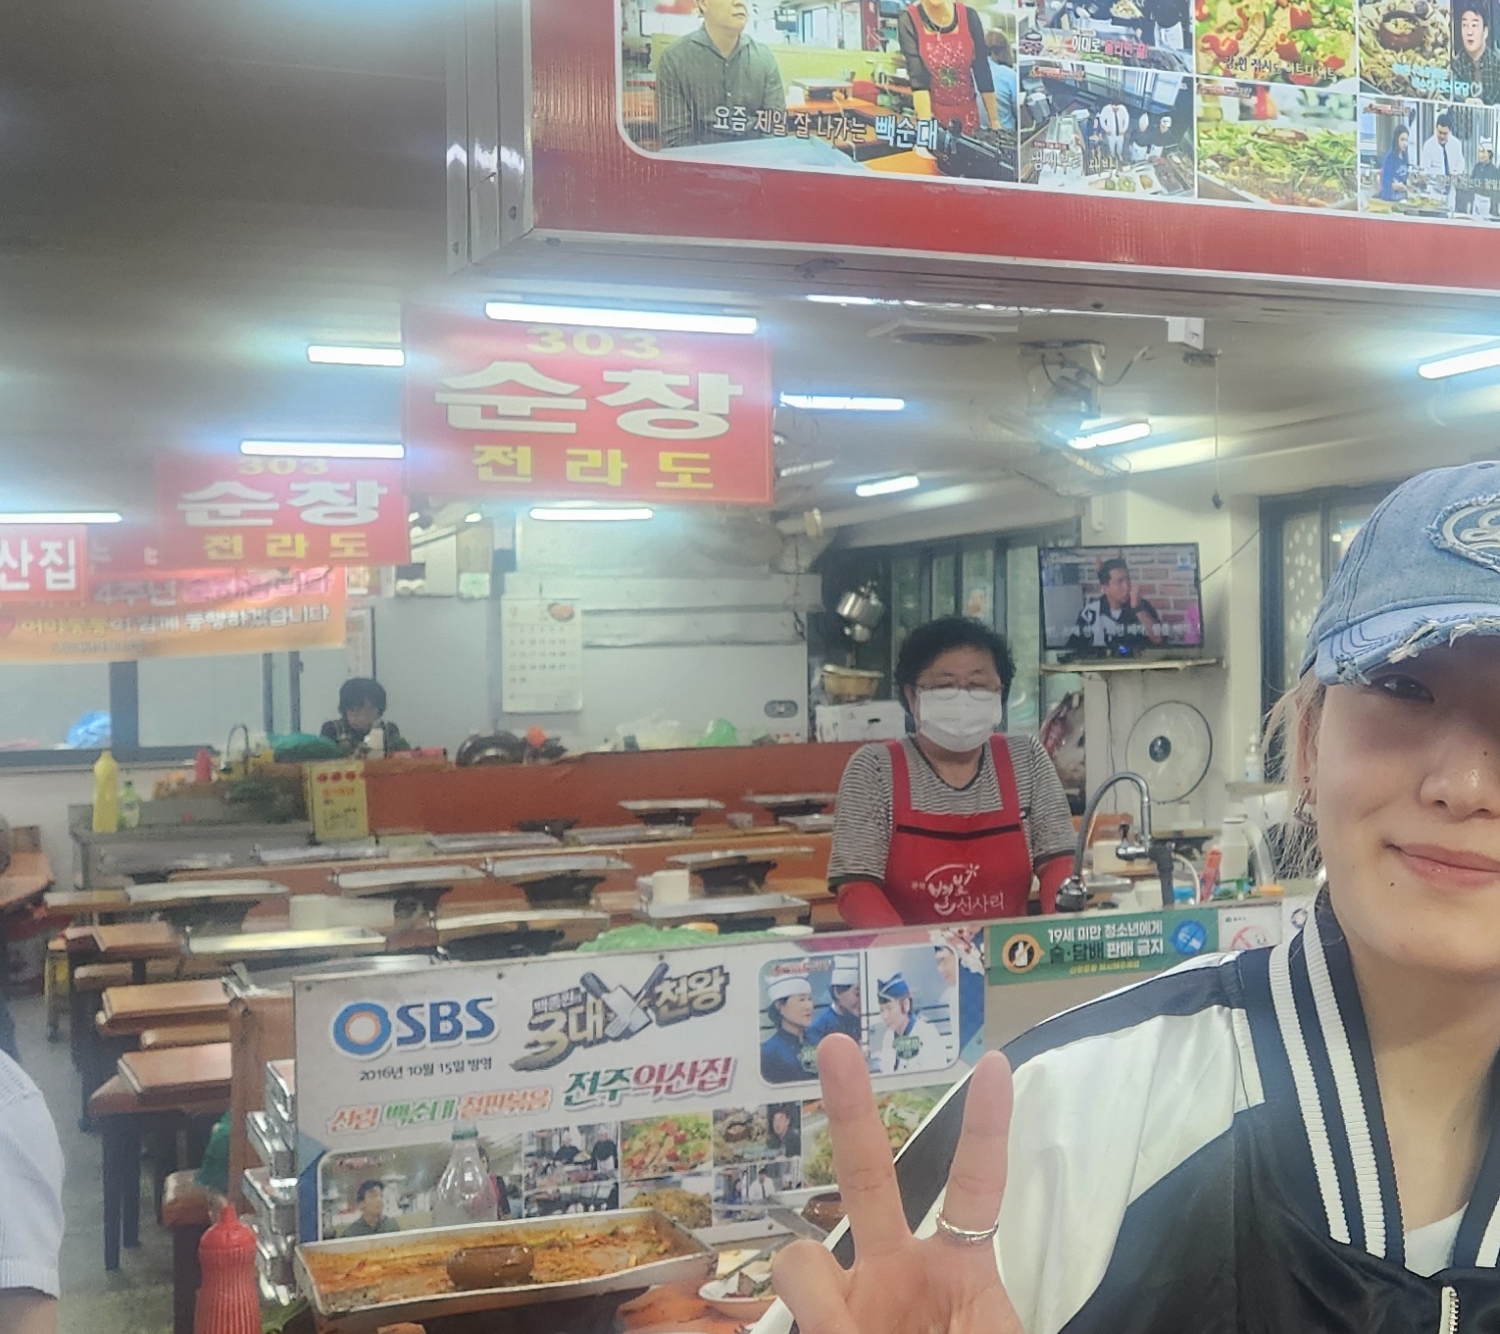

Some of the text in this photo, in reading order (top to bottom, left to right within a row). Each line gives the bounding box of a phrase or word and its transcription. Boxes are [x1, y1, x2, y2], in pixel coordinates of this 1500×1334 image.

[712, 105, 938, 151] 요즘 제일 잘 나가는 빽순대
[525, 326, 662, 360] 303
[434, 360, 744, 440] 순창
[472, 444, 715, 490] 전라도
[176, 480, 388, 527] 순창
[204, 532, 370, 561] 전라도
[956, 891, 1005, 916] 신사리
[1047, 919, 1163, 944] 19세 미만 청소년에게
[1106, 940, 1134, 959] 판매
[1137, 937, 1164, 957] 금지
[654, 965, 727, 1019] 천왕
[396, 996, 496, 1047] SBS
[359, 1065, 403, 1082] 2016년
[408, 1063, 435, 1078] 10월
[439, 1060, 465, 1076] 15일
[562, 1056, 733, 1107] 전주익산집
